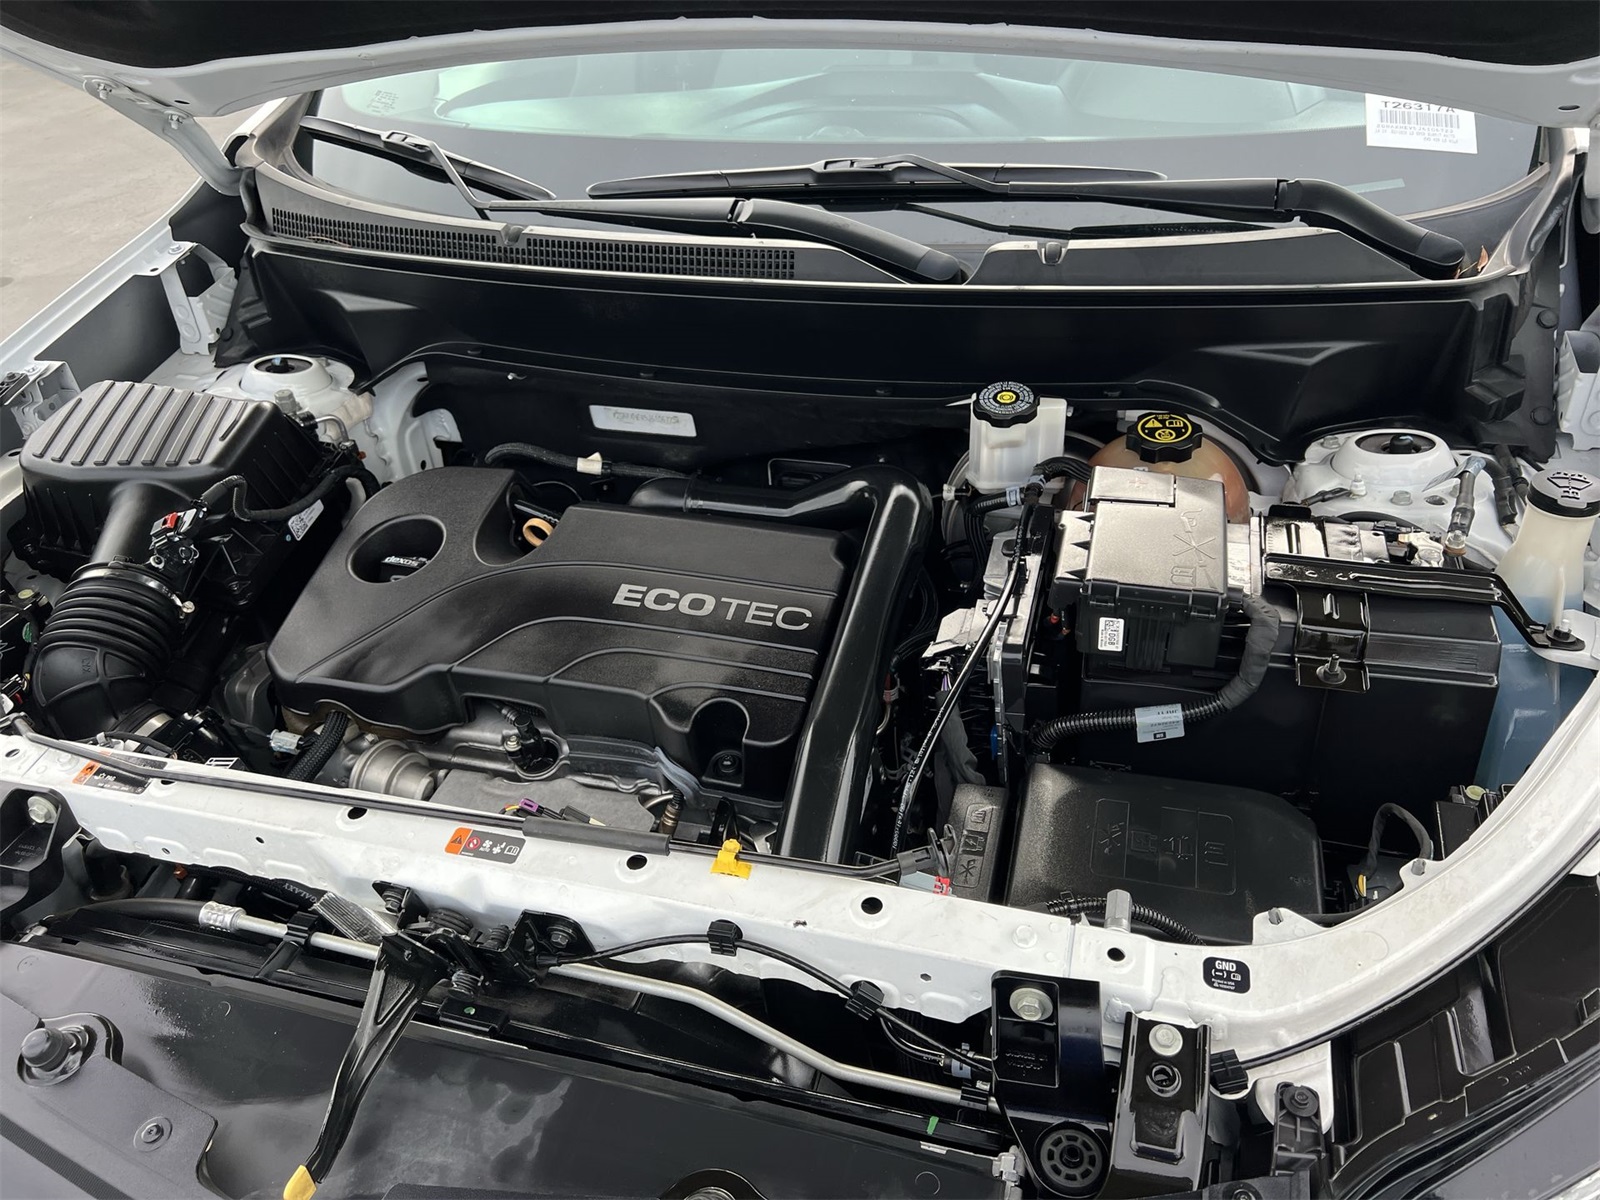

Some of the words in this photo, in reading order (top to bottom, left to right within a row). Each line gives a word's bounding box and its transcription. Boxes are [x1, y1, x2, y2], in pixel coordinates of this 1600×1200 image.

[612, 583, 813, 631] ECOTEC
[282, 882, 318, 903] GALAXY
[1215, 960, 1237, 972] GND
